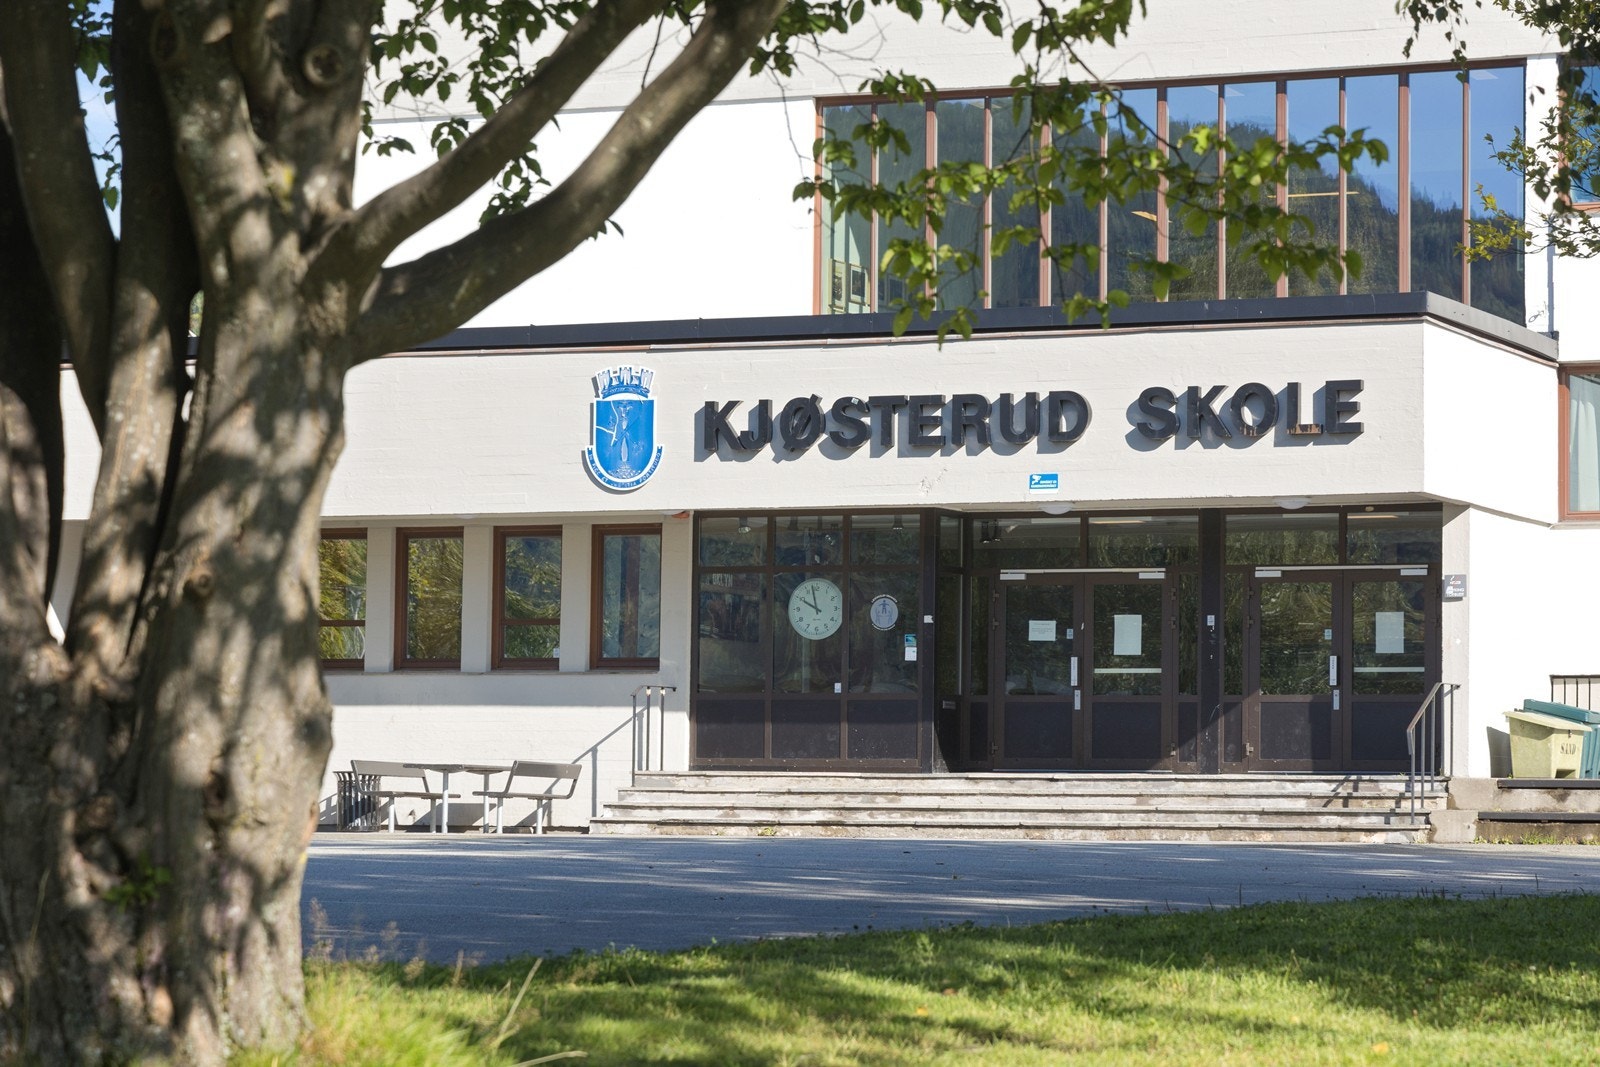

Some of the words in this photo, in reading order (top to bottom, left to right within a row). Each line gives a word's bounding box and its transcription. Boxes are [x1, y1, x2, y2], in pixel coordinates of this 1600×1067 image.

[703, 390, 1092, 453] KJØSTERUD
[1136, 379, 1364, 440] SKOLE
[1560, 742, 1577, 756] SAND
